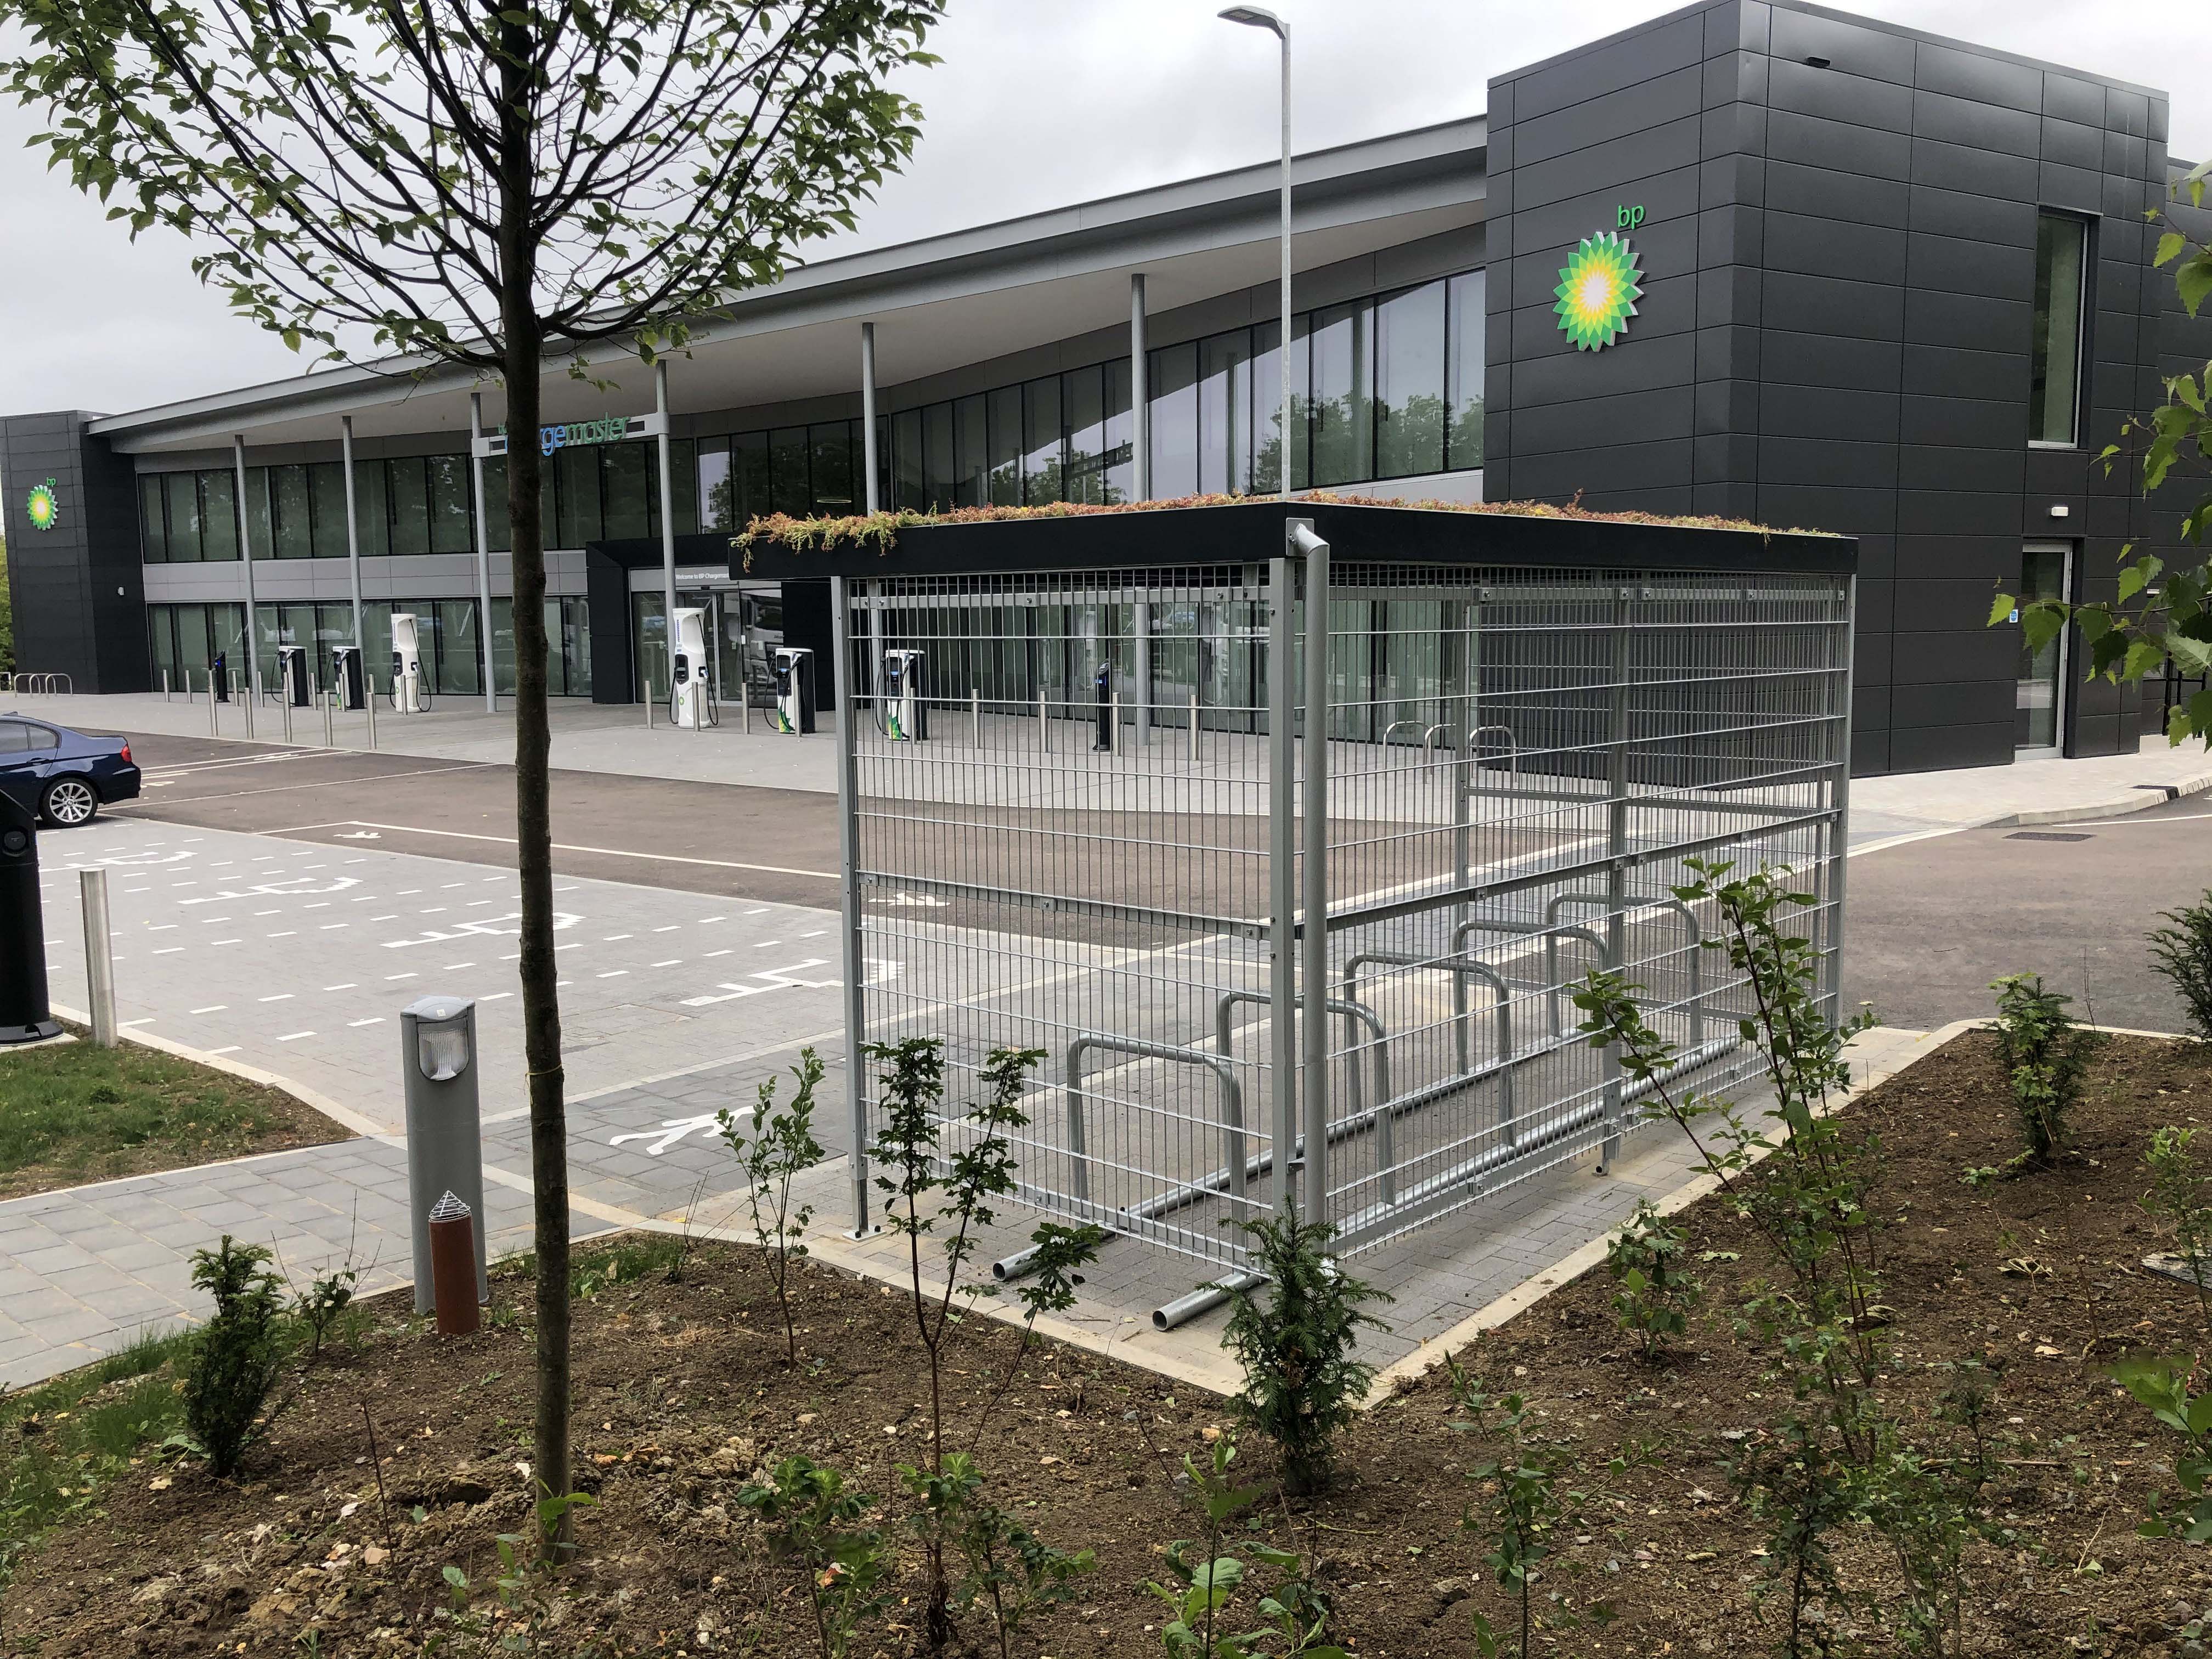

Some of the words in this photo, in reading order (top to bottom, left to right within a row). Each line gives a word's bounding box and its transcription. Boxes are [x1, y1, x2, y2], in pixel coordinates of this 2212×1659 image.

[1618, 205, 1644, 229] bp
[504, 411, 630, 456] gemaster
[47, 477, 55, 487] bp
